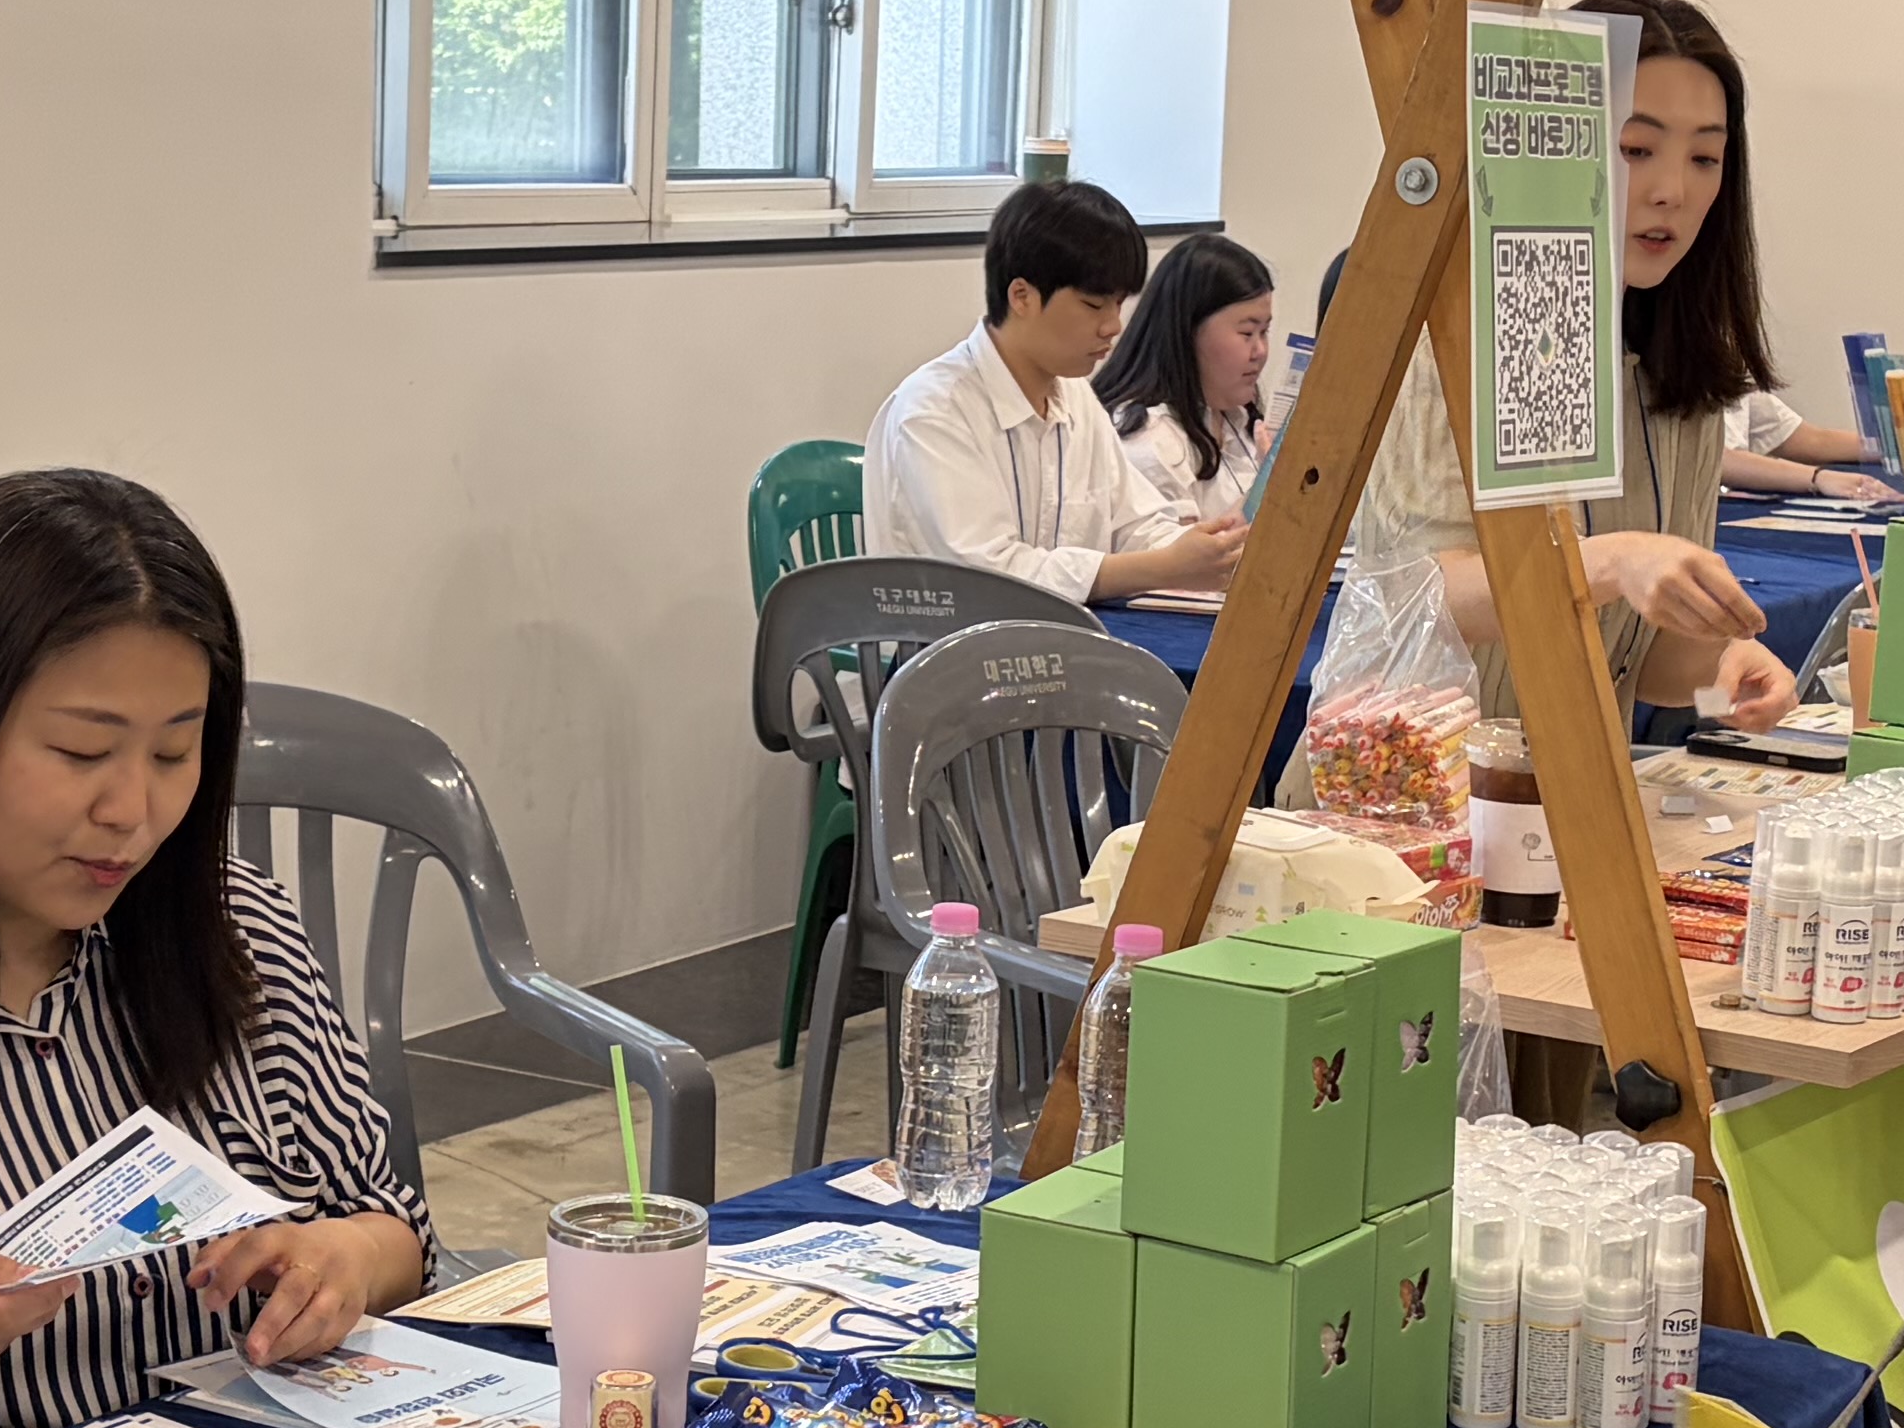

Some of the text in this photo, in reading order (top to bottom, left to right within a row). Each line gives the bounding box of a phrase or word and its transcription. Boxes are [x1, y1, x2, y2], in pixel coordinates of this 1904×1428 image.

[1472, 51, 1604, 109] 비교과프로그램
[1481, 111, 1600, 160] 신청 바로가기
[906, 605, 955, 617] UNIVERSITY
[982, 653, 1065, 683] 대구대학교
[1018, 680, 1067, 696] UNIVERSITY
[1835, 929, 1869, 941] RISE
[1662, 1318, 1698, 1332] RISE
